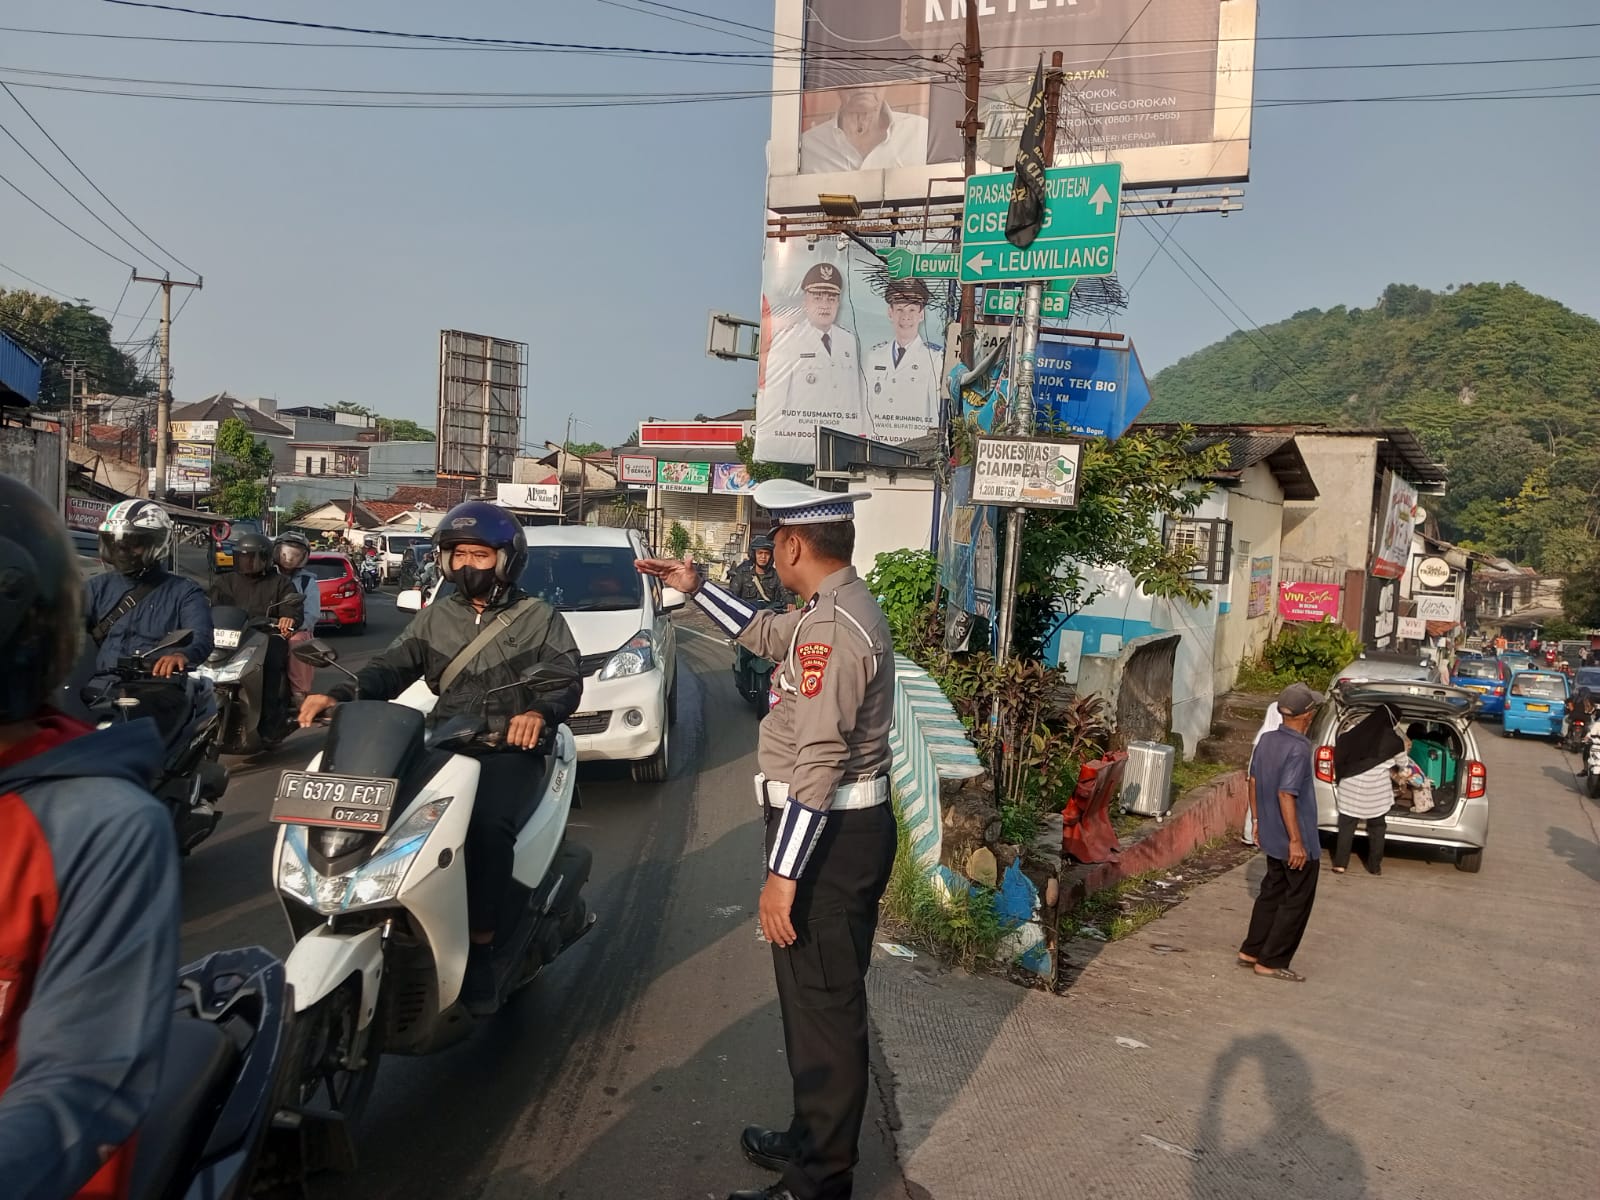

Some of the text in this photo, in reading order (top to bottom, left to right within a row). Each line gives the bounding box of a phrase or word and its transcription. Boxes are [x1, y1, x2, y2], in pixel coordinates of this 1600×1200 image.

[1090, 96, 1176, 112] TENGGOROKAN
[969, 182, 1012, 205] PRASAS
[1045, 177, 1090, 198] RUTEUN
[967, 209, 1052, 233] CISEG
[999, 246, 1109, 271] LEUWILIANG
[1037, 358, 1072, 370] SITUS
[1069, 379, 1092, 390] TEK
[1095, 381, 1116, 392] BIO
[1056, 394, 1070, 402] KM
[802, 411, 844, 419] SUSMANTO,
[979, 443, 1050, 460] PUSKESMAS
[976, 461, 1040, 478] CIAMPEA
[995, 485, 1015, 496] METER
[1284, 592, 1304, 602] VIVI
[286, 781, 384, 805] F 6379 FCT
[335, 810, 379, 823] 07-23
